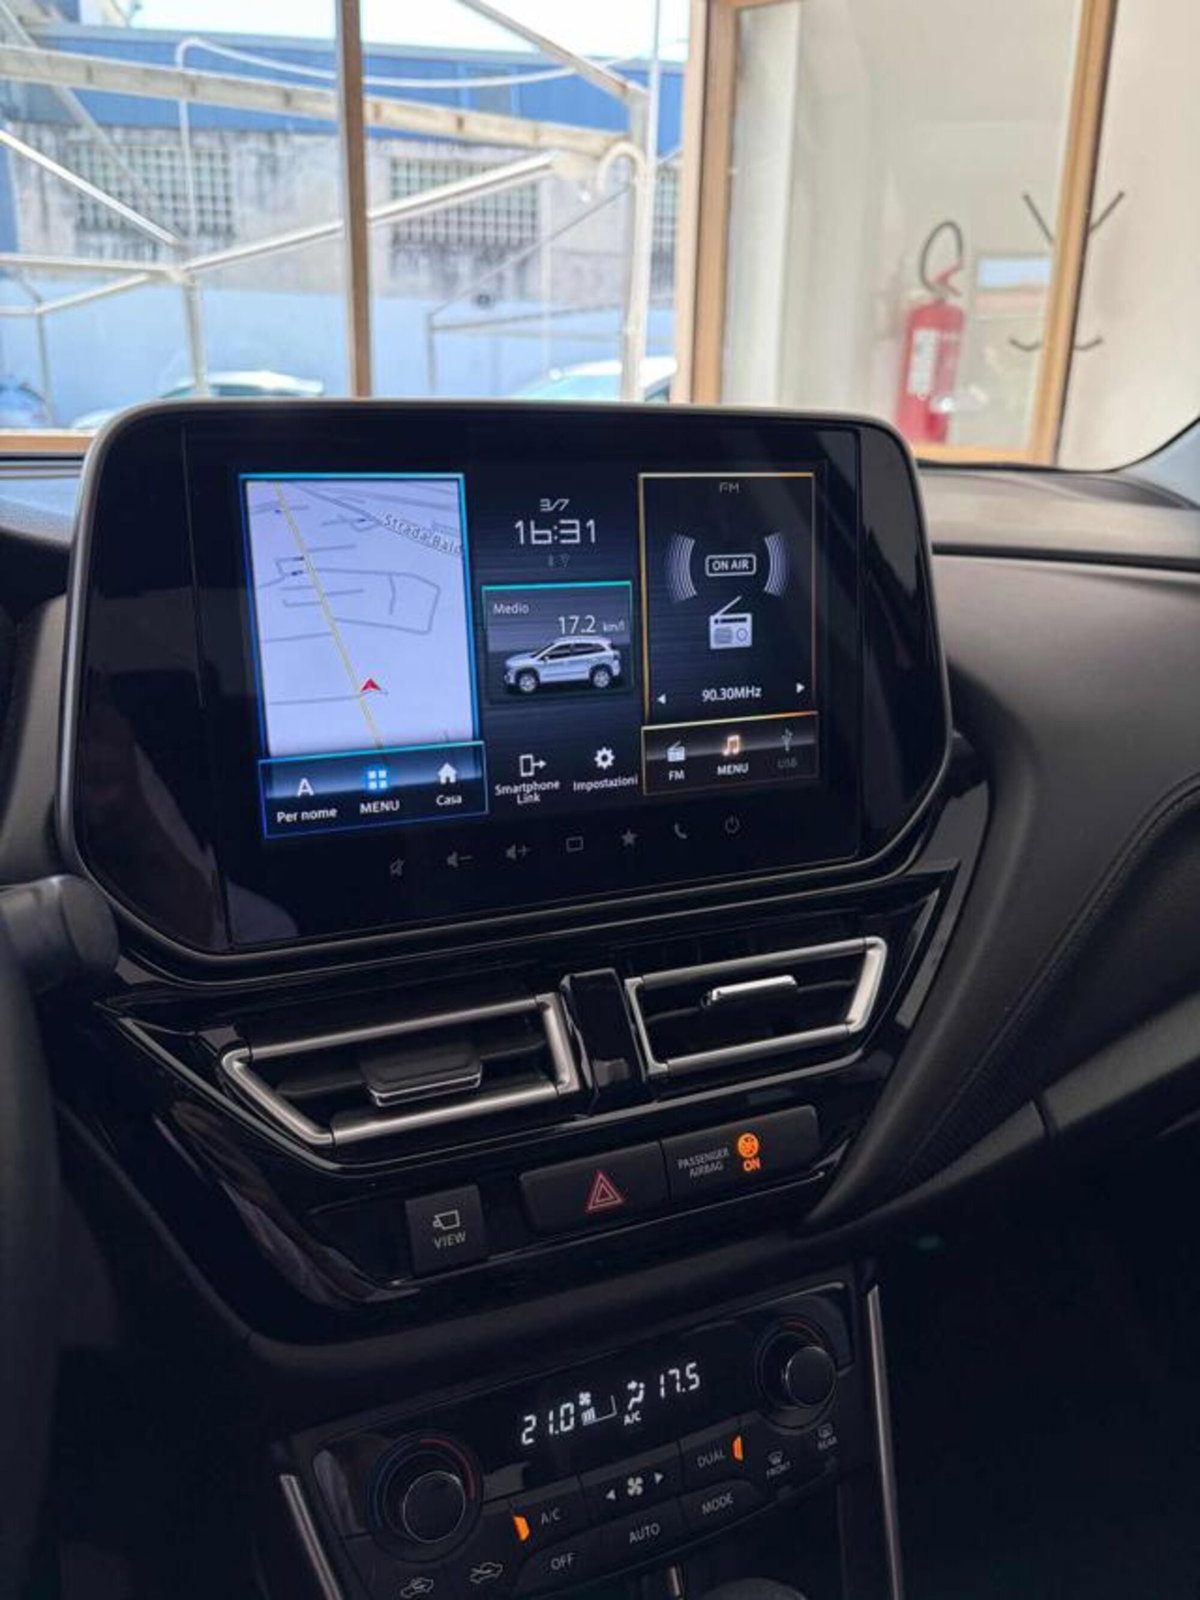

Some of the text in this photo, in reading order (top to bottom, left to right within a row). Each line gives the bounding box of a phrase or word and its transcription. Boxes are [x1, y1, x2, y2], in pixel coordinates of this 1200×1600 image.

[719, 481, 740, 494] FM
[540, 498, 570, 512] 3/7
[384, 513, 428, 541] Strada
[514, 519, 596, 545] 16:31
[712, 559, 750, 571] ON AIR
[493, 602, 530, 615] Medio
[558, 614, 626, 634] 17.2 km/l
[702, 685, 762, 702] 90.30MHz
[668, 769, 686, 782] FM
[717, 763, 749, 776] MENU
[494, 780, 561, 796] Smartphone
[573, 774, 638, 792] Impostazioni
[359, 800, 400, 814] MENU
[436, 794, 462, 806] Casa
[516, 792, 541, 805] Link
[276, 808, 338, 823] Per nome
[678, 1147, 730, 1170] PASSENGER
[743, 1157, 761, 1172] ON
[689, 1161, 724, 1179] AIRBAG
[434, 1231, 466, 1249] VIEW
[659, 1362, 700, 1399] 17.5
[521, 1402, 575, 1445] 21.0
[623, 1411, 642, 1426] A/C
[697, 1449, 726, 1468] DUAL
[766, 1460, 792, 1479] FRONT
[702, 1491, 735, 1515] MODE
[541, 1507, 561, 1525] A/C
[629, 1522, 661, 1544] AUTO
[550, 1552, 575, 1571] OFF
